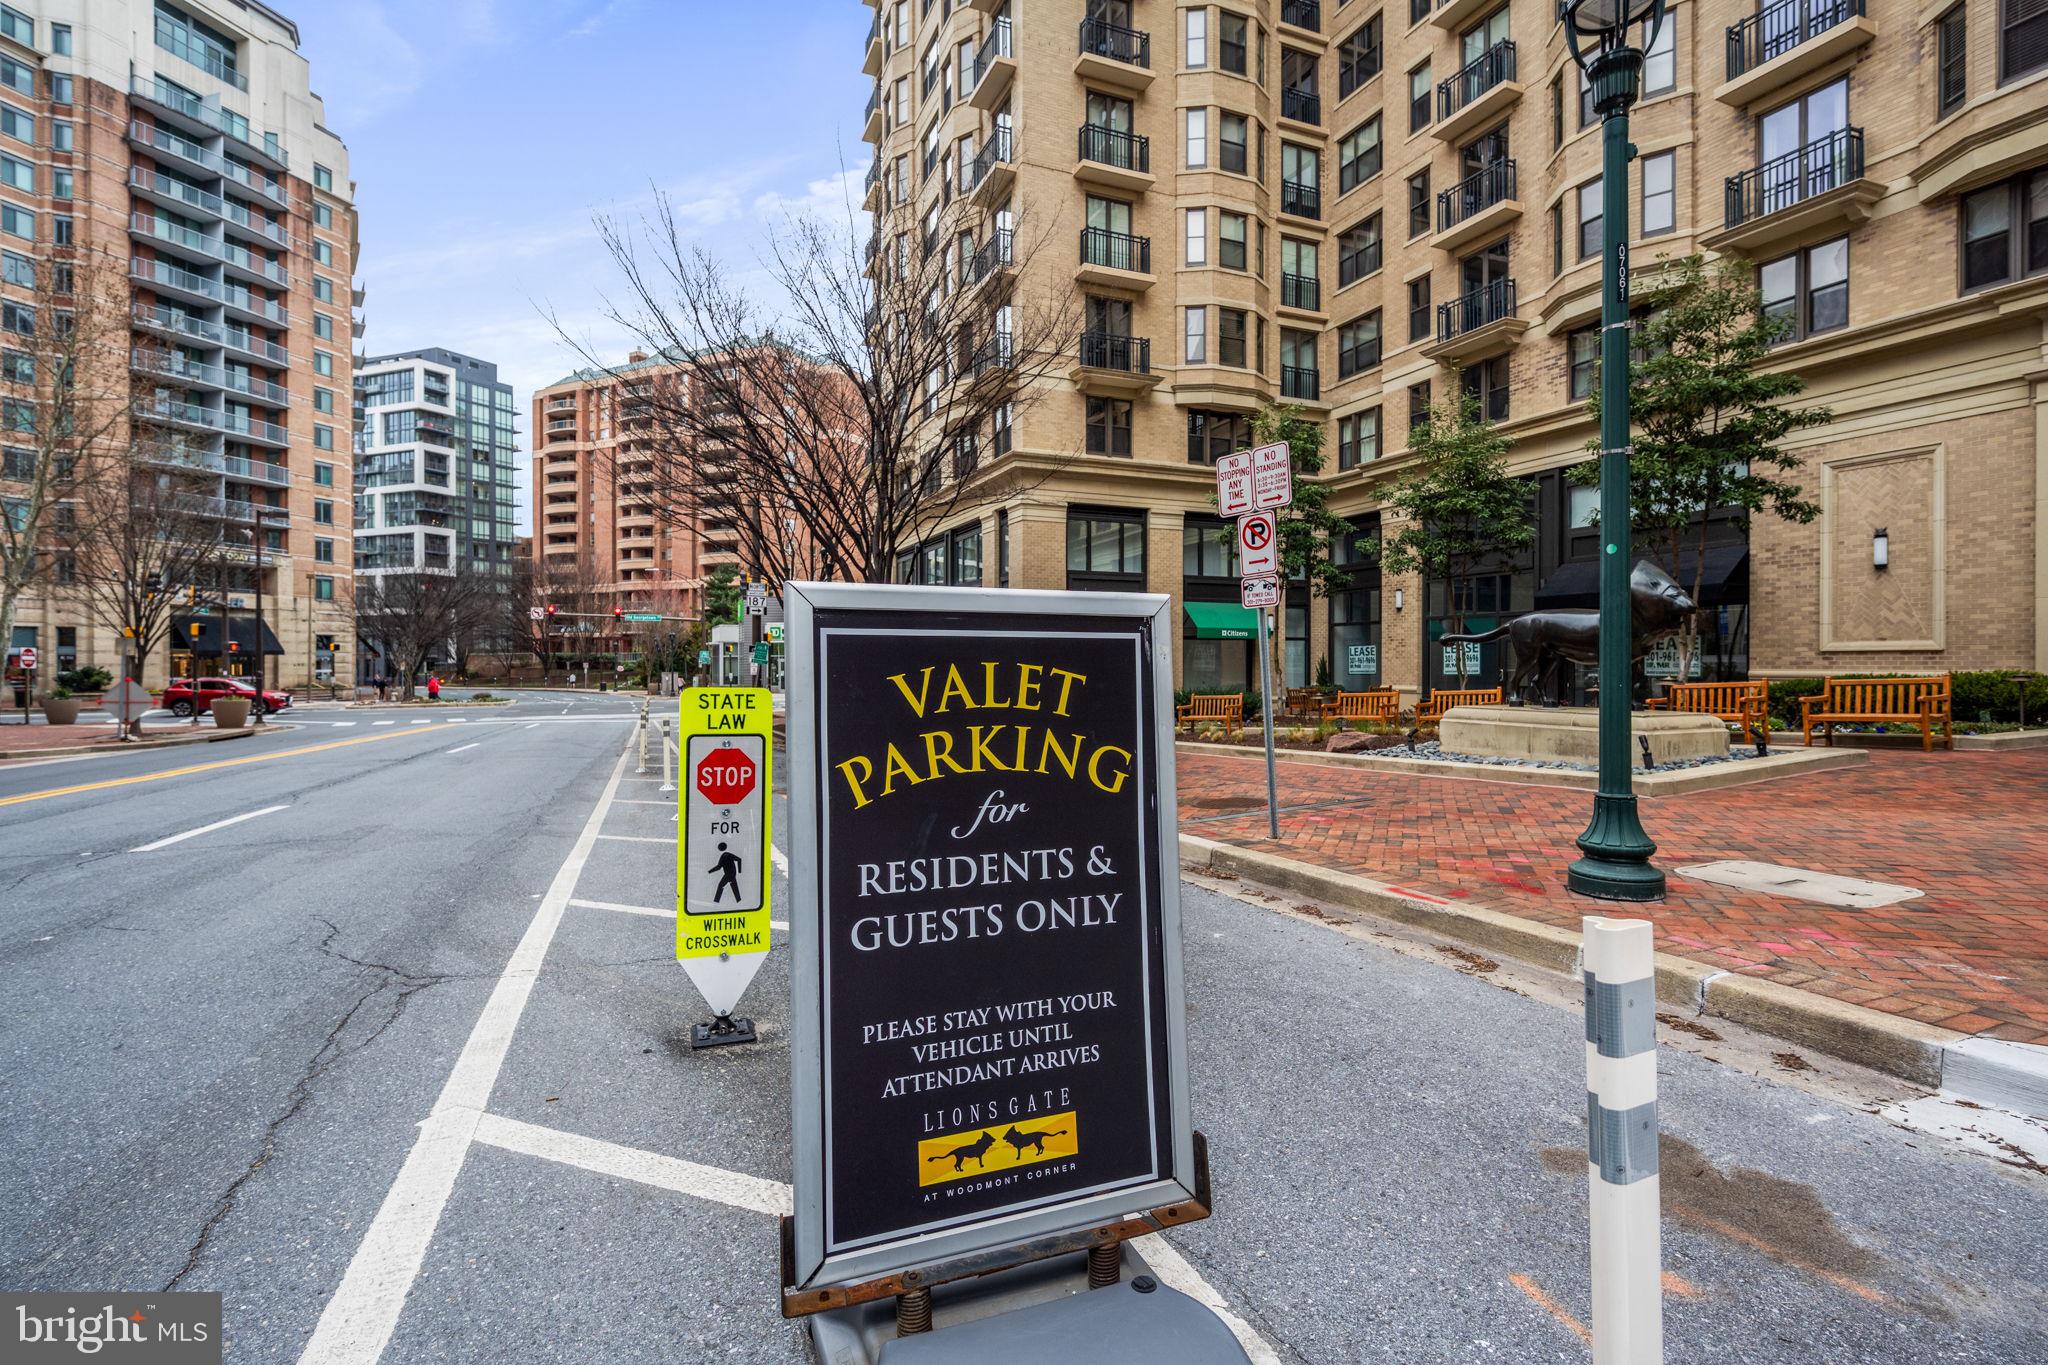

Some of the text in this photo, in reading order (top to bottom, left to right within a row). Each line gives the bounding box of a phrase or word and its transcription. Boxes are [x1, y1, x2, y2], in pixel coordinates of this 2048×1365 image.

[1228, 458, 1240, 469] NO
[1264, 450, 1276, 462] NO
[1220, 466, 1250, 482] STOPPING
[1256, 459, 1287, 475] STANDING
[1228, 479, 1243, 490] ANY
[1228, 489, 1245, 501] TIME
[748, 597, 766, 606] 187
[1349, 647, 1376, 657] LEASE
[886, 661, 1087, 718] VALET
[698, 693, 756, 710] STATE
[707, 714, 746, 730] LAW
[700, 766, 752, 787] STOP
[835, 725, 1133, 811] PARKING
[950, 789, 1030, 839] for
[711, 822, 740, 835] FOR
[858, 845, 1117, 897] RESIDENTS &
[703, 916, 746, 932] WITHIN
[850, 893, 1123, 952] GUESTS ONLY
[686, 932, 761, 950] CROSSWALK
[862, 991, 1117, 1044] PLEASE STAY WITH YOUR
[911, 1023, 1073, 1064] VEHICLE UNTIL
[881, 1044, 1100, 1099] ATTENDANT ARRIVES
[923, 1163, 1077, 1203] AT WOODMONT CORNER
